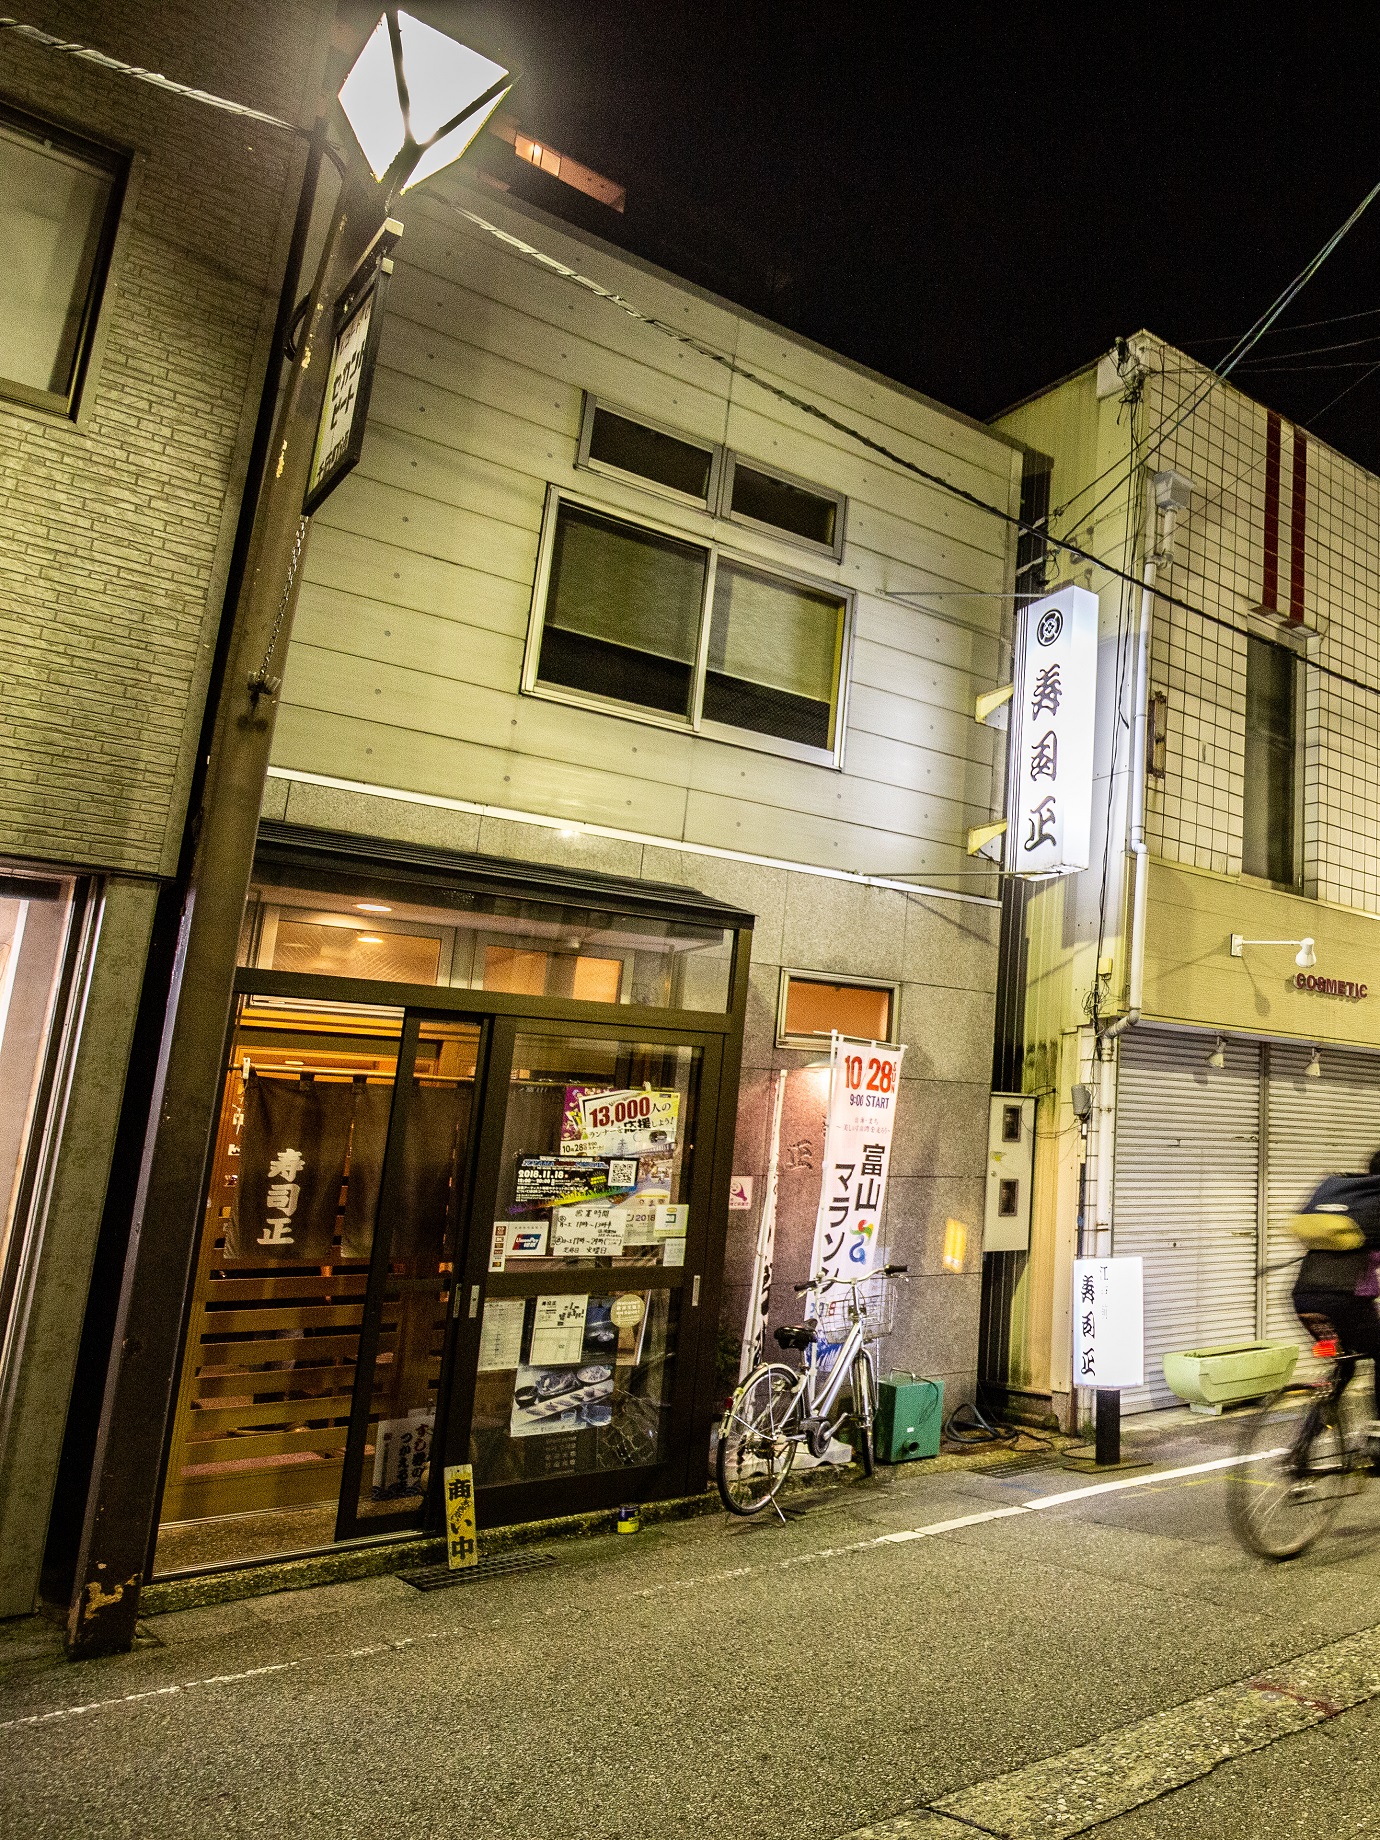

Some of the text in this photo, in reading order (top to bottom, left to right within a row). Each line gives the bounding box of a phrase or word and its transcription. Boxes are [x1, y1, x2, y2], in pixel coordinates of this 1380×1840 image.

[1296, 972, 1368, 999] COSMETIC
[845, 1055, 893, 1094] 10/28
[850, 1094, 889, 1109] 9:00 START
[256, 1148, 305, 1245] 寿司正
[518, 1169, 564, 1179] 2018.11.18
[854, 1143, 885, 1212] 富山
[819, 1163, 856, 1295] マラソン
[448, 1478, 475, 1561] 商い中
